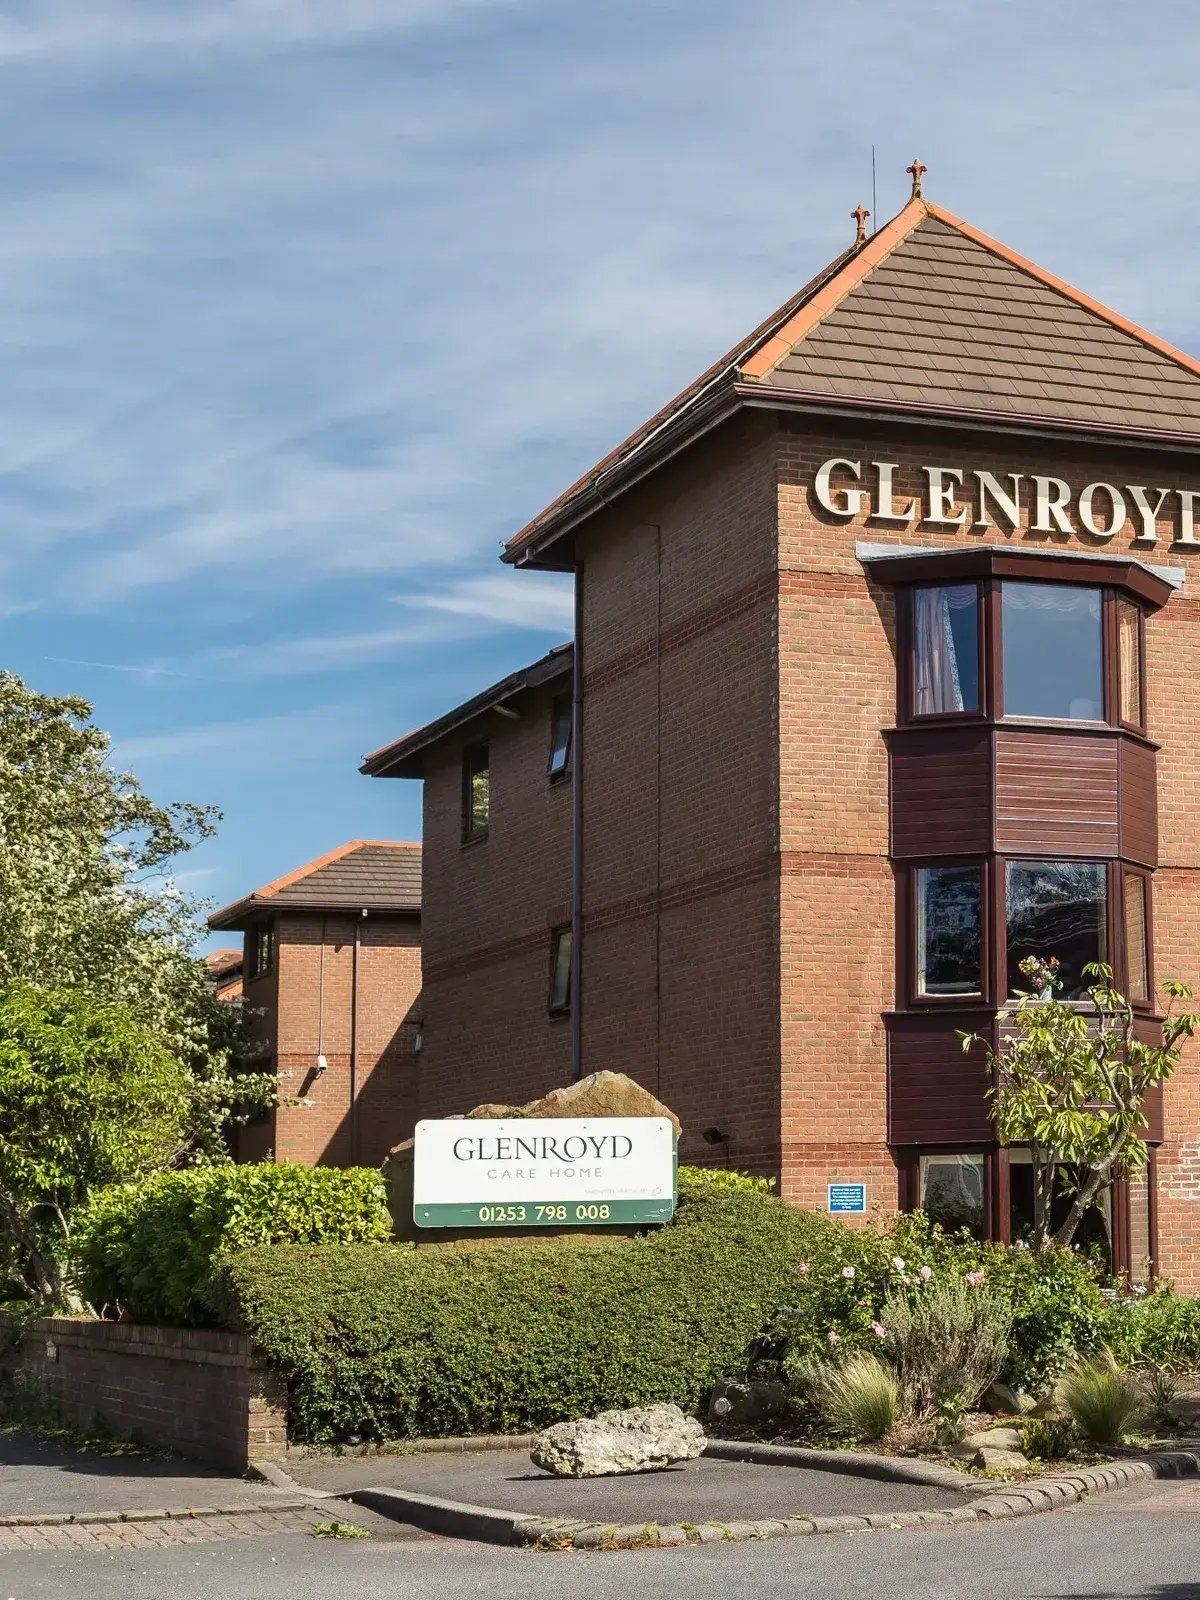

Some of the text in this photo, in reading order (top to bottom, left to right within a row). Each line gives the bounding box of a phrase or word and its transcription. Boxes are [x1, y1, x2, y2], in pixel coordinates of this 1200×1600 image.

[453, 1135, 632, 1162] GLENROYD
[487, 1167, 602, 1180] CARE HOME
[479, 1205, 610, 1222] 01253 798 008
